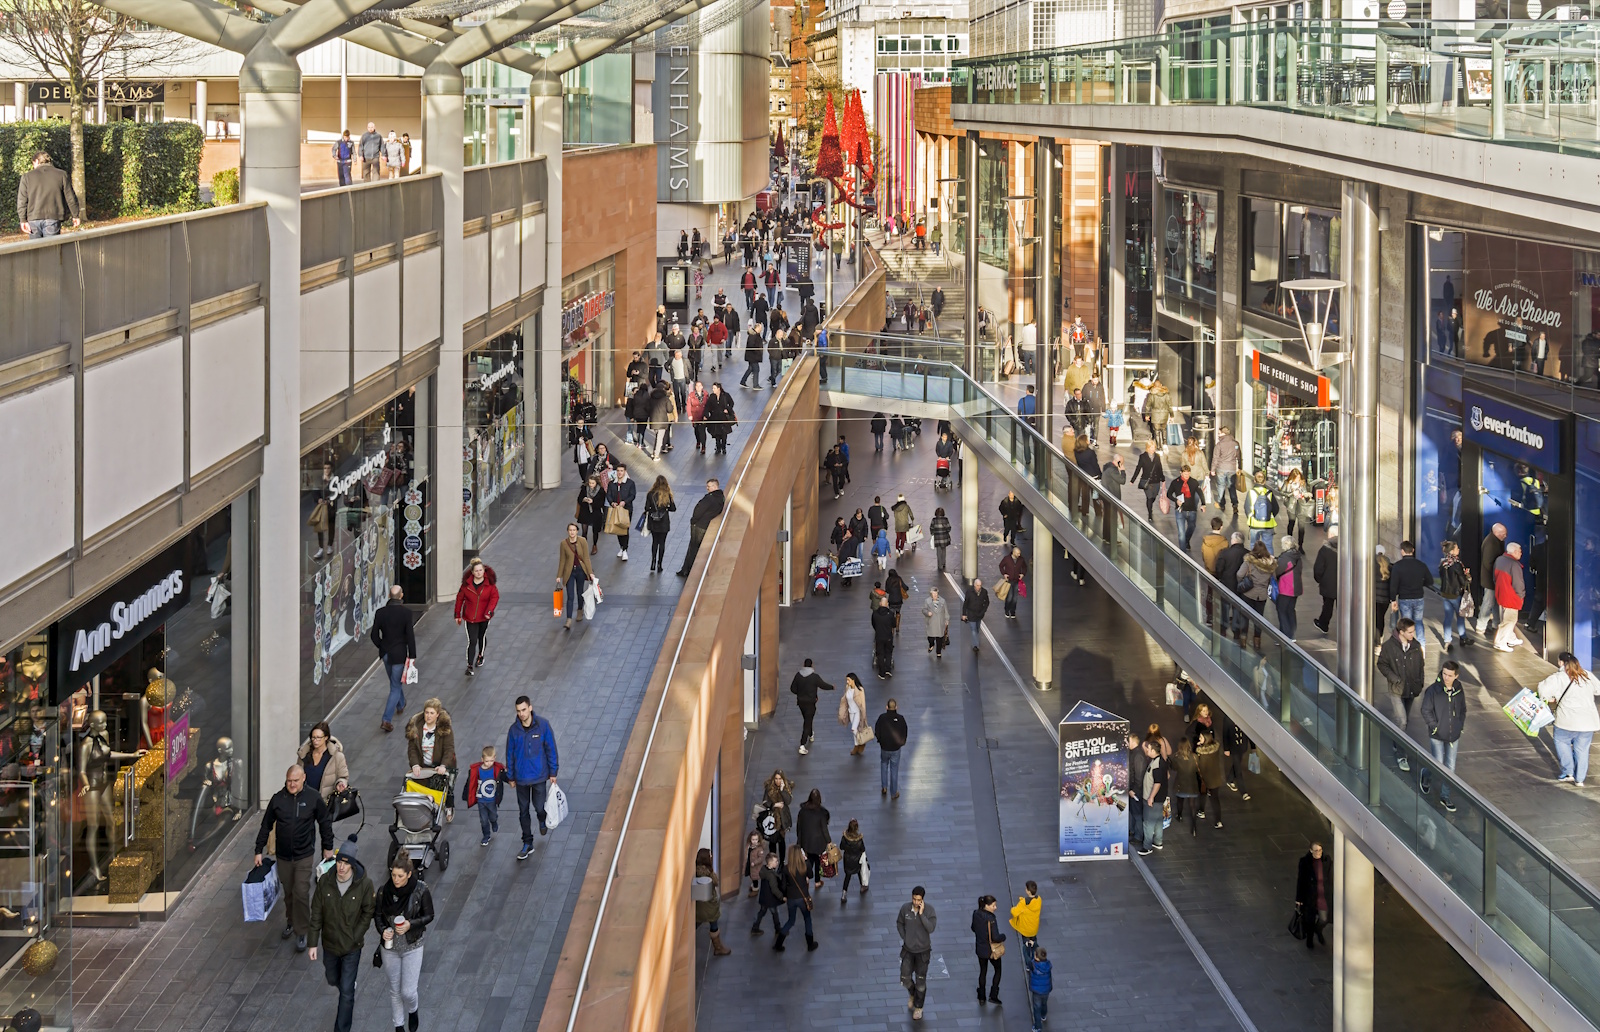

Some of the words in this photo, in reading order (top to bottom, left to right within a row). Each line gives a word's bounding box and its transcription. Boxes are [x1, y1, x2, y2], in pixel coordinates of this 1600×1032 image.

[40, 86, 154, 99] DEBNHAMS
[984, 64, 1017, 90] TERRACE
[1474, 288, 1493, 311] We
[1494, 294, 1519, 318] Are
[1520, 298, 1562, 328] Chosen
[481, 361, 515, 391] Superdrug
[1259, 362, 1270, 375] THE
[1272, 368, 1299, 387] PERFUME
[1300, 380, 1318, 395] SHOP
[1483, 416, 1544, 450] evertontwo
[328, 449, 387, 501] Superdrug
[69, 629, 111, 671] Ann
[110, 569, 183, 639] Summers
[1065, 740, 1085, 751] SEE
[1085, 736, 1106, 747] YOU
[1065, 750, 1080, 759] ON
[1081, 746, 1100, 757] THE
[1100, 743, 1119, 754] ICE.
